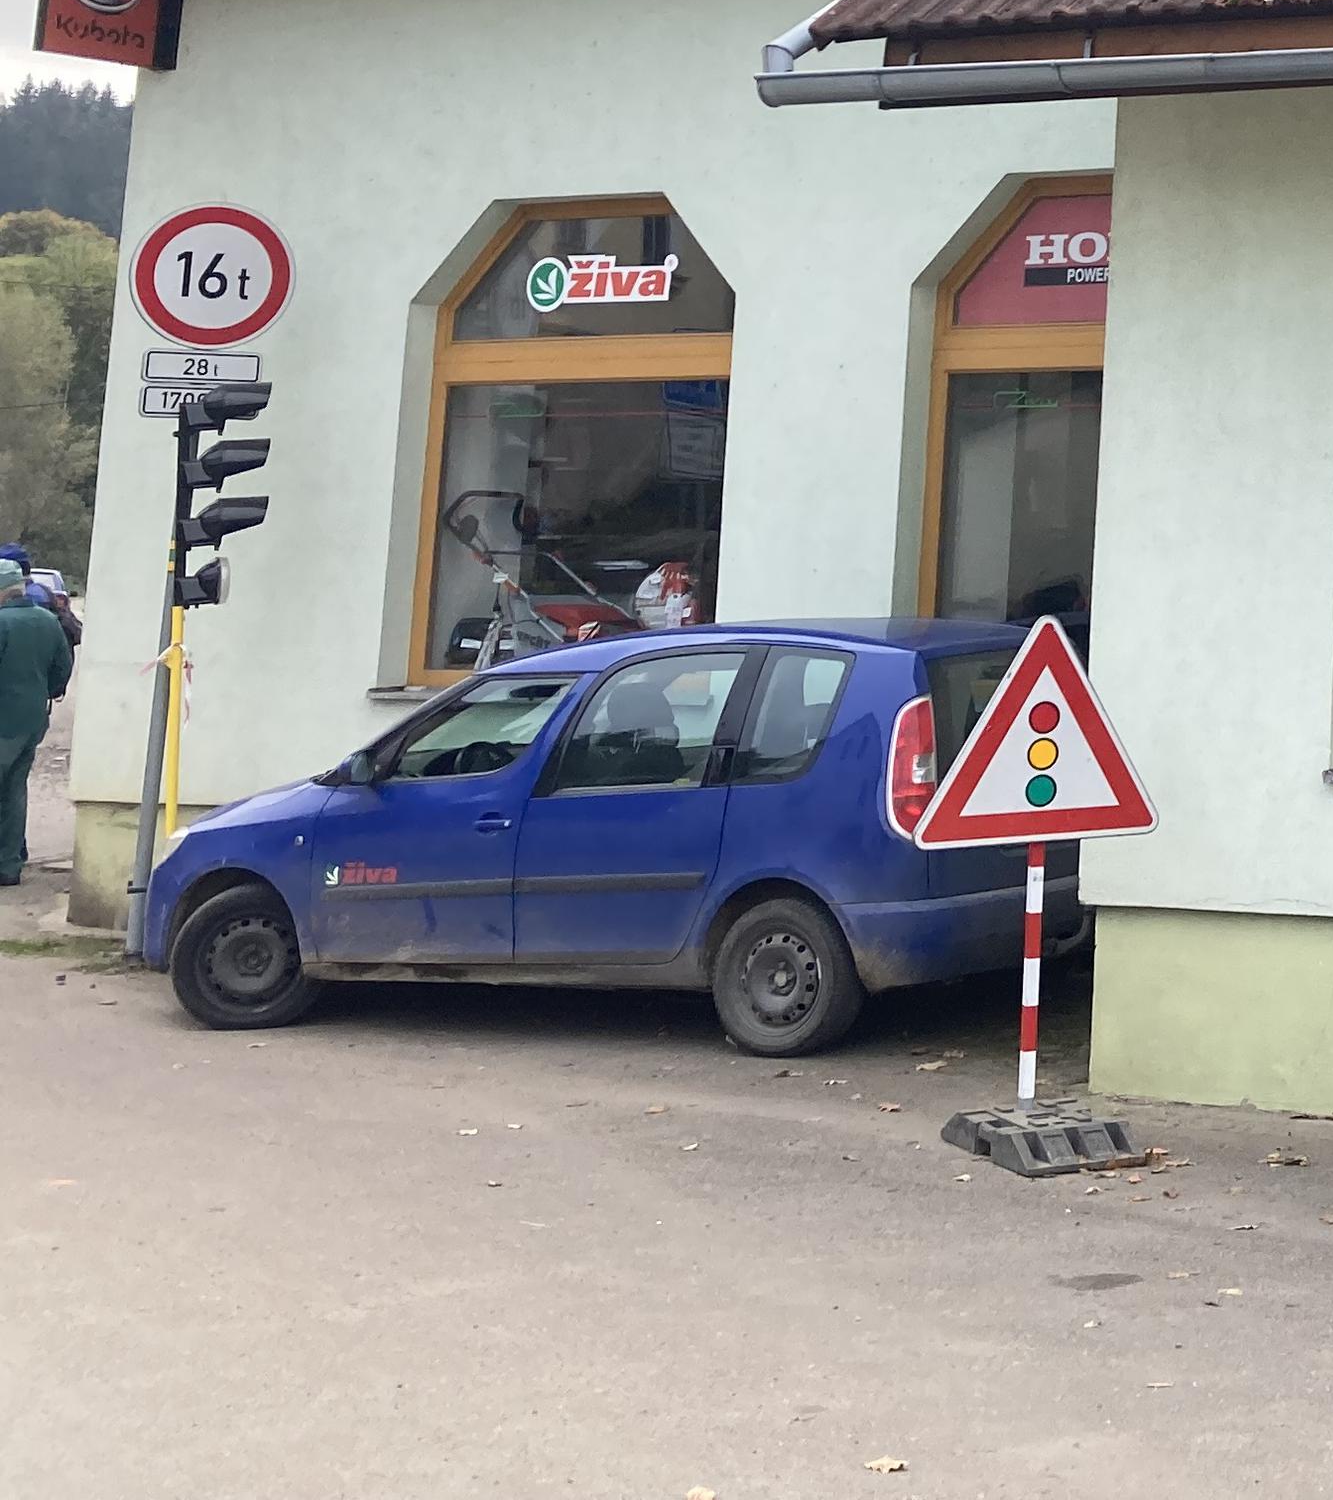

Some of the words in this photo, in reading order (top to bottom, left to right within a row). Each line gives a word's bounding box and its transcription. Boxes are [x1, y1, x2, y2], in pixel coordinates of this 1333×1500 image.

[56, 13, 145, 49] Kubota
[1024, 231, 1112, 266] HO
[176, 251, 228, 299] 16
[238, 268, 250, 300] t
[567, 260, 666, 298] živa
[183, 358, 209, 376] 28
[213, 364, 219, 377] t
[342, 861, 398, 884] živa
